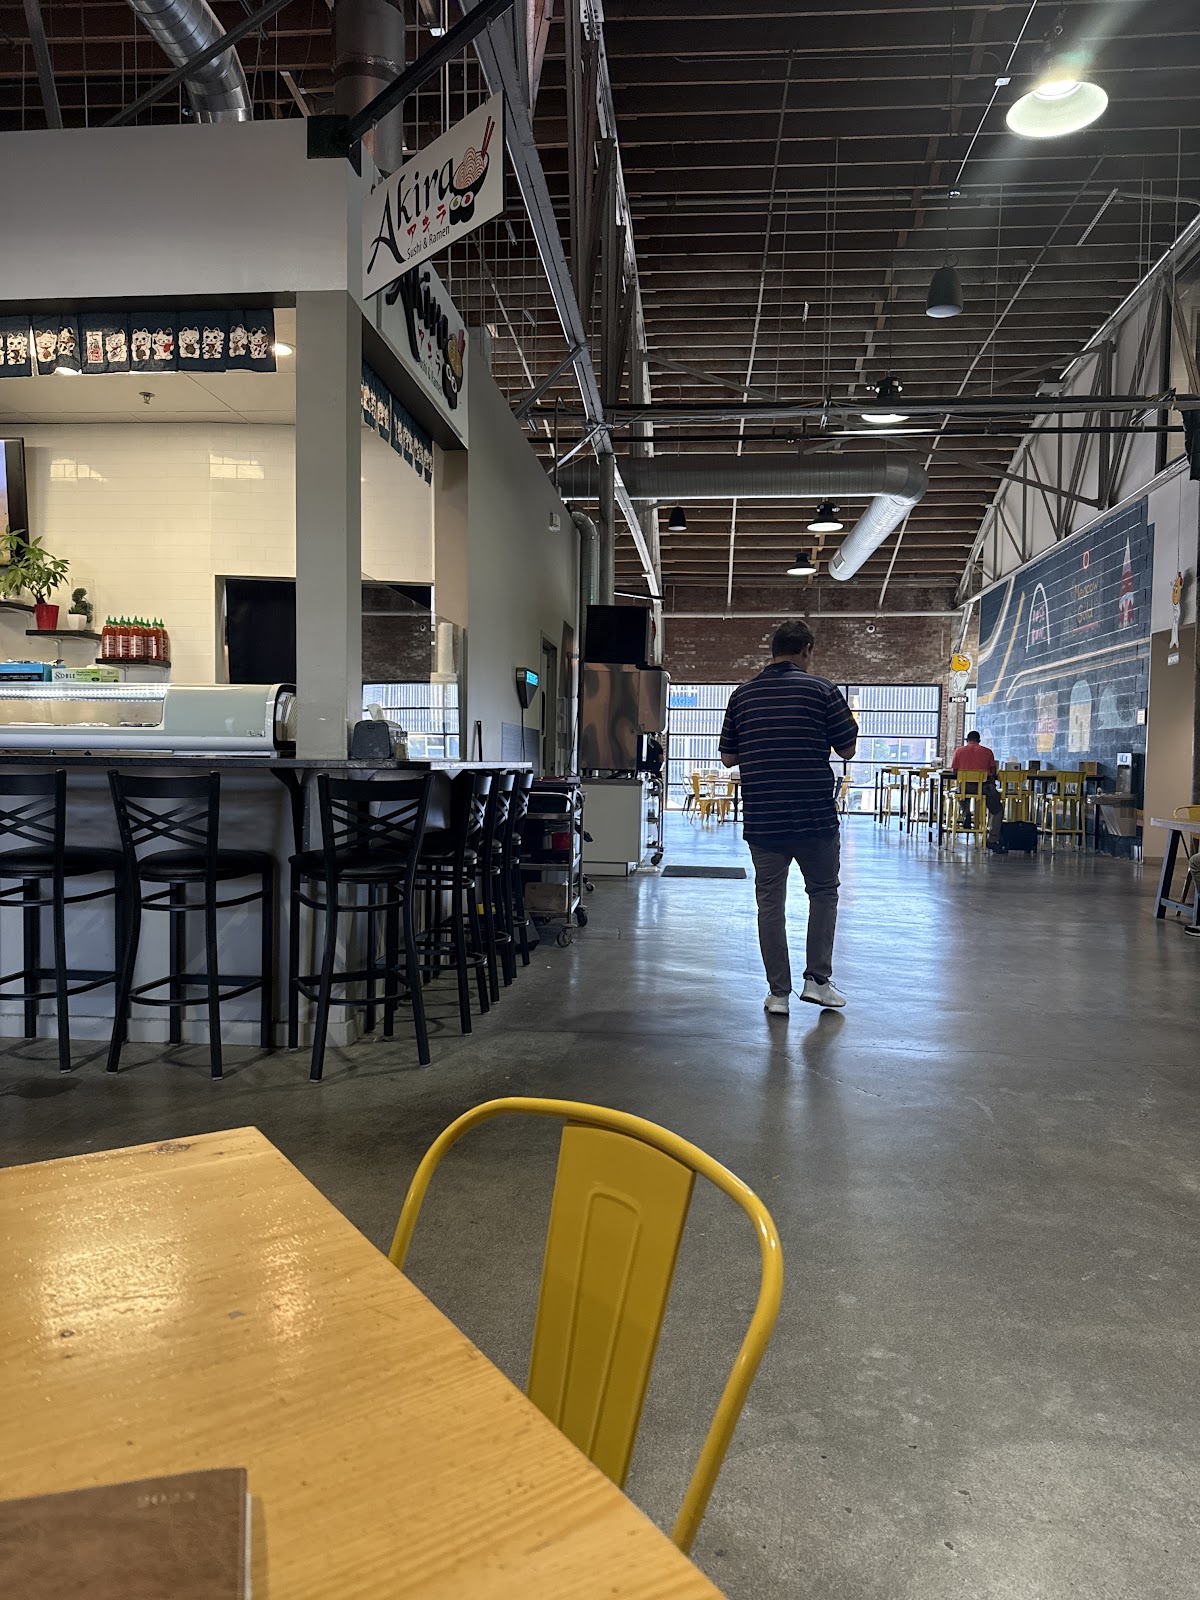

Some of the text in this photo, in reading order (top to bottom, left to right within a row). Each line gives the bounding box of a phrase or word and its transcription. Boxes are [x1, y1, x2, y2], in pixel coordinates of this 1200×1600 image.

[367, 157, 455, 274] Akira
[406, 226, 450, 260] Sushi & Ramen
